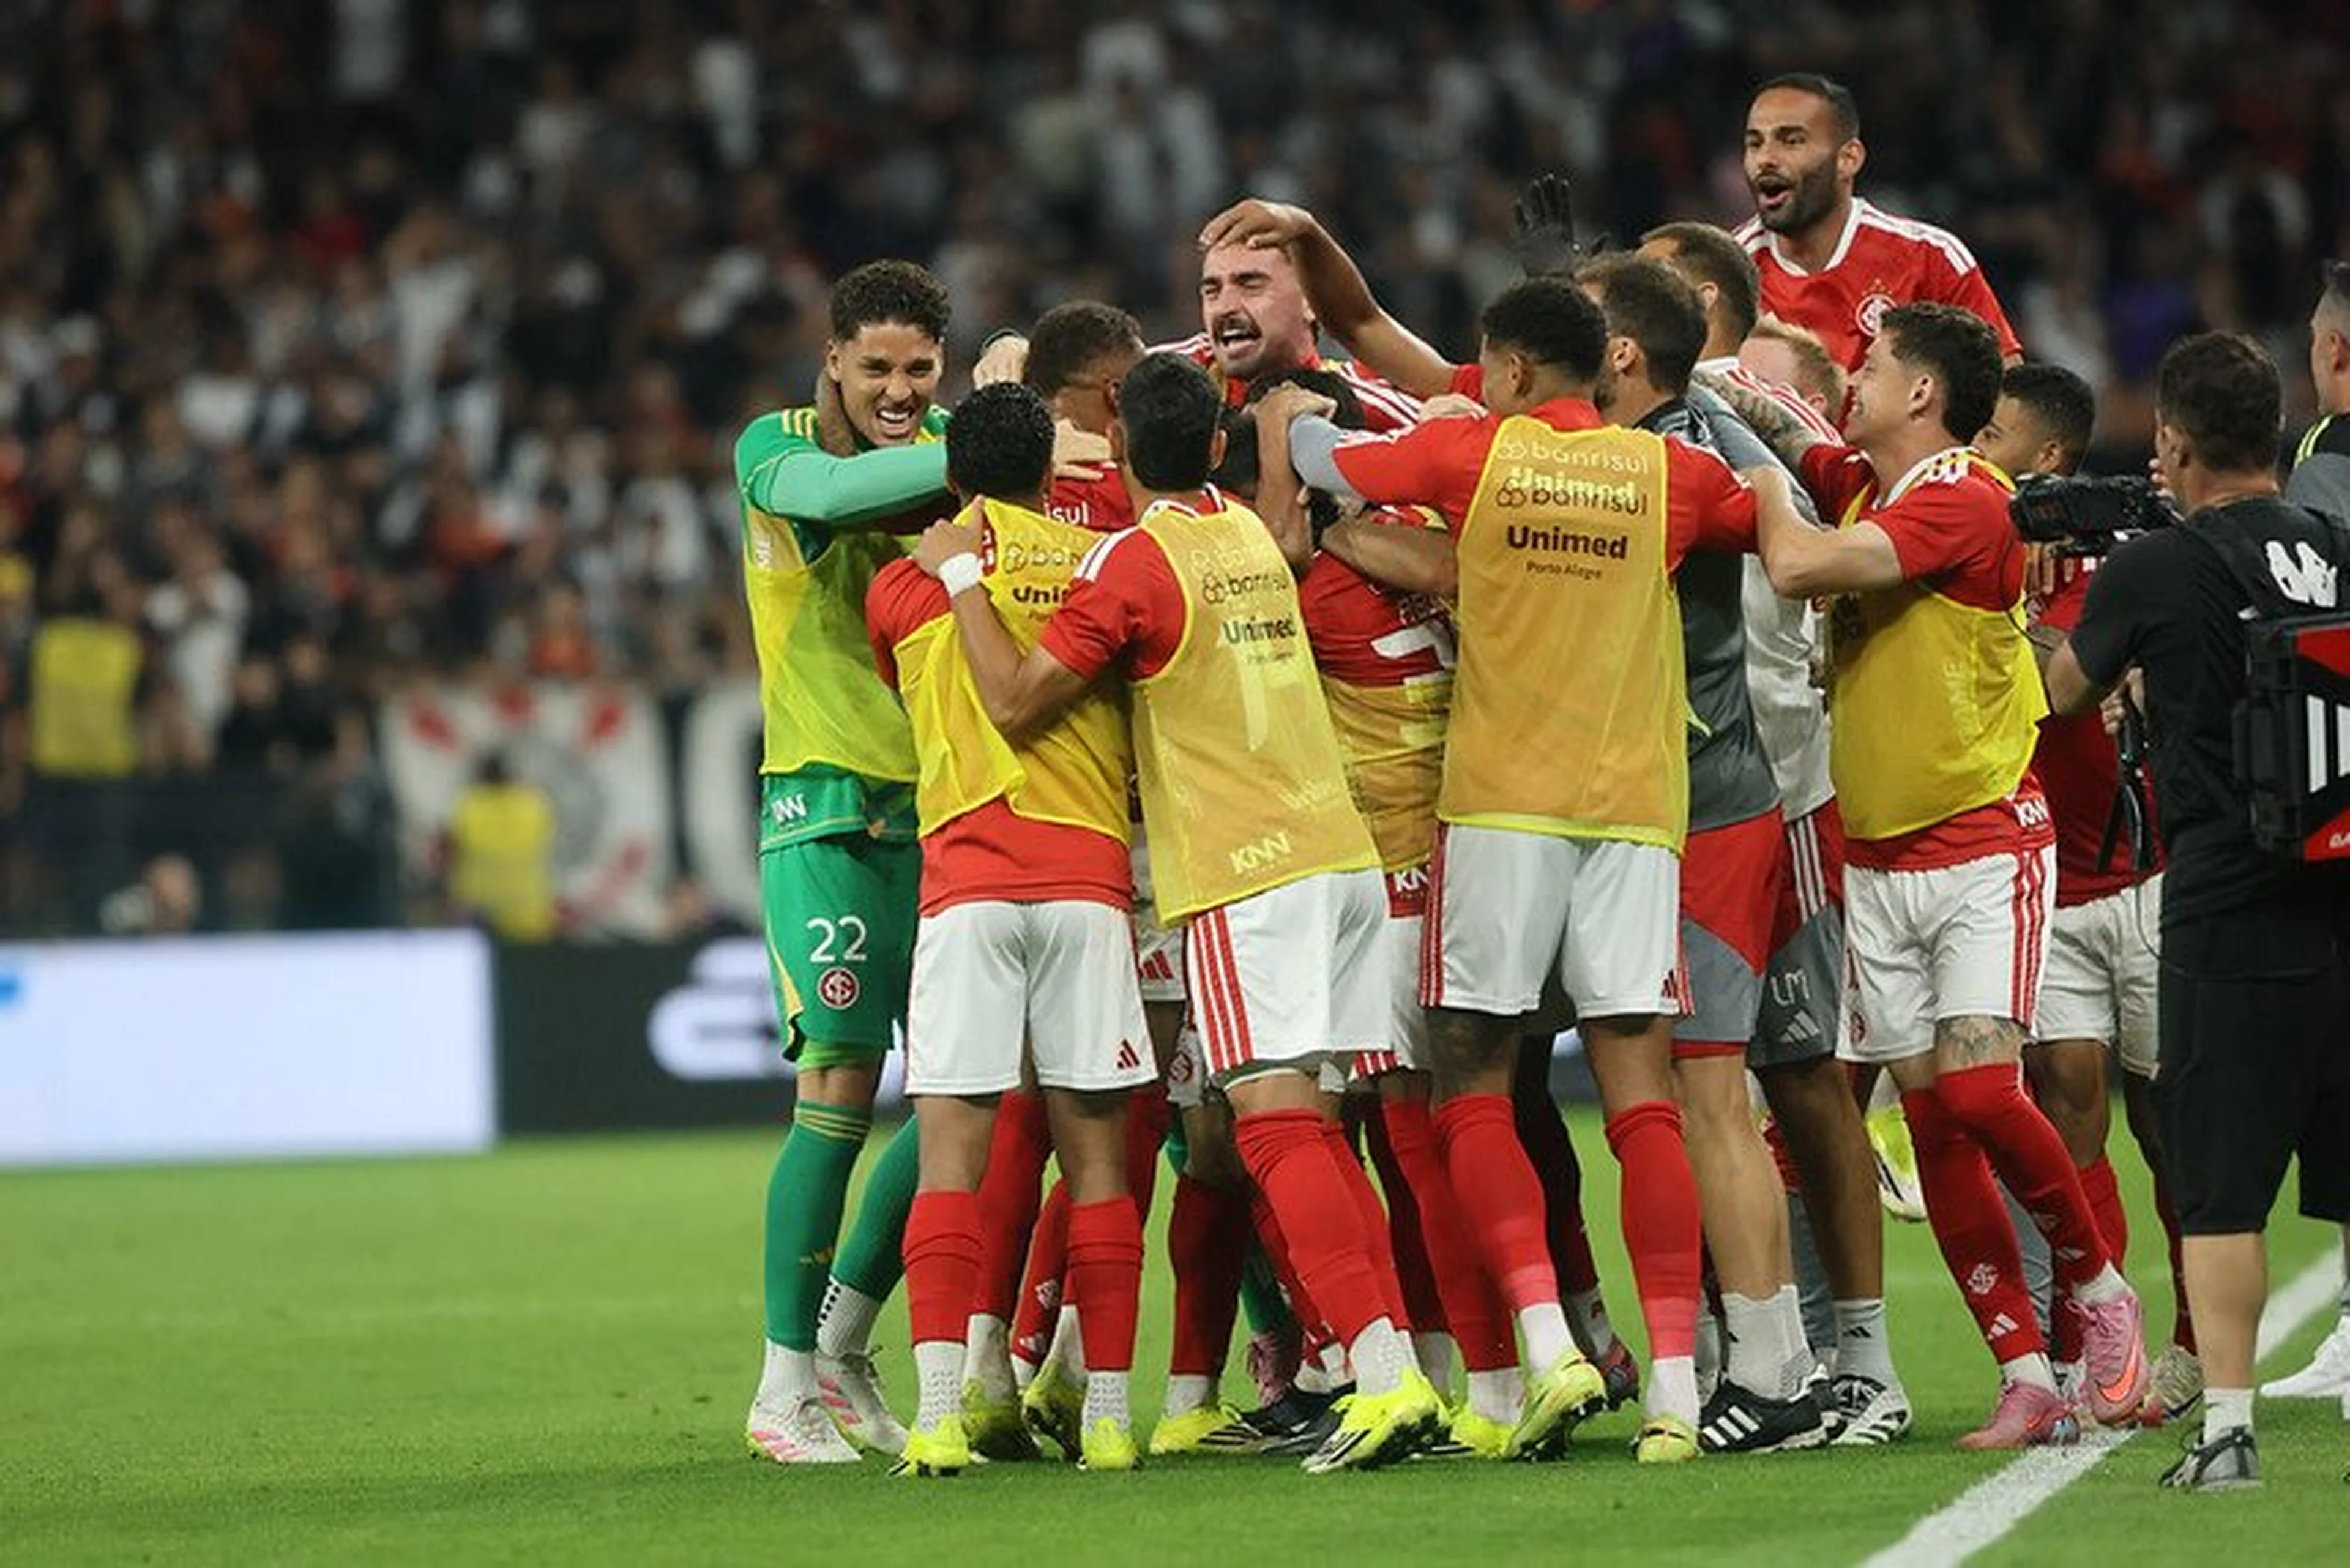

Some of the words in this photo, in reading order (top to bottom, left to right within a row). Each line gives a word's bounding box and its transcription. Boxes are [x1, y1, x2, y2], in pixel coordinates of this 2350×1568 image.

[1532, 441, 1648, 474] banrisul
[1507, 525, 1628, 559] Unimed
[1229, 832, 1291, 874] KNN
[807, 916, 867, 963] 22
